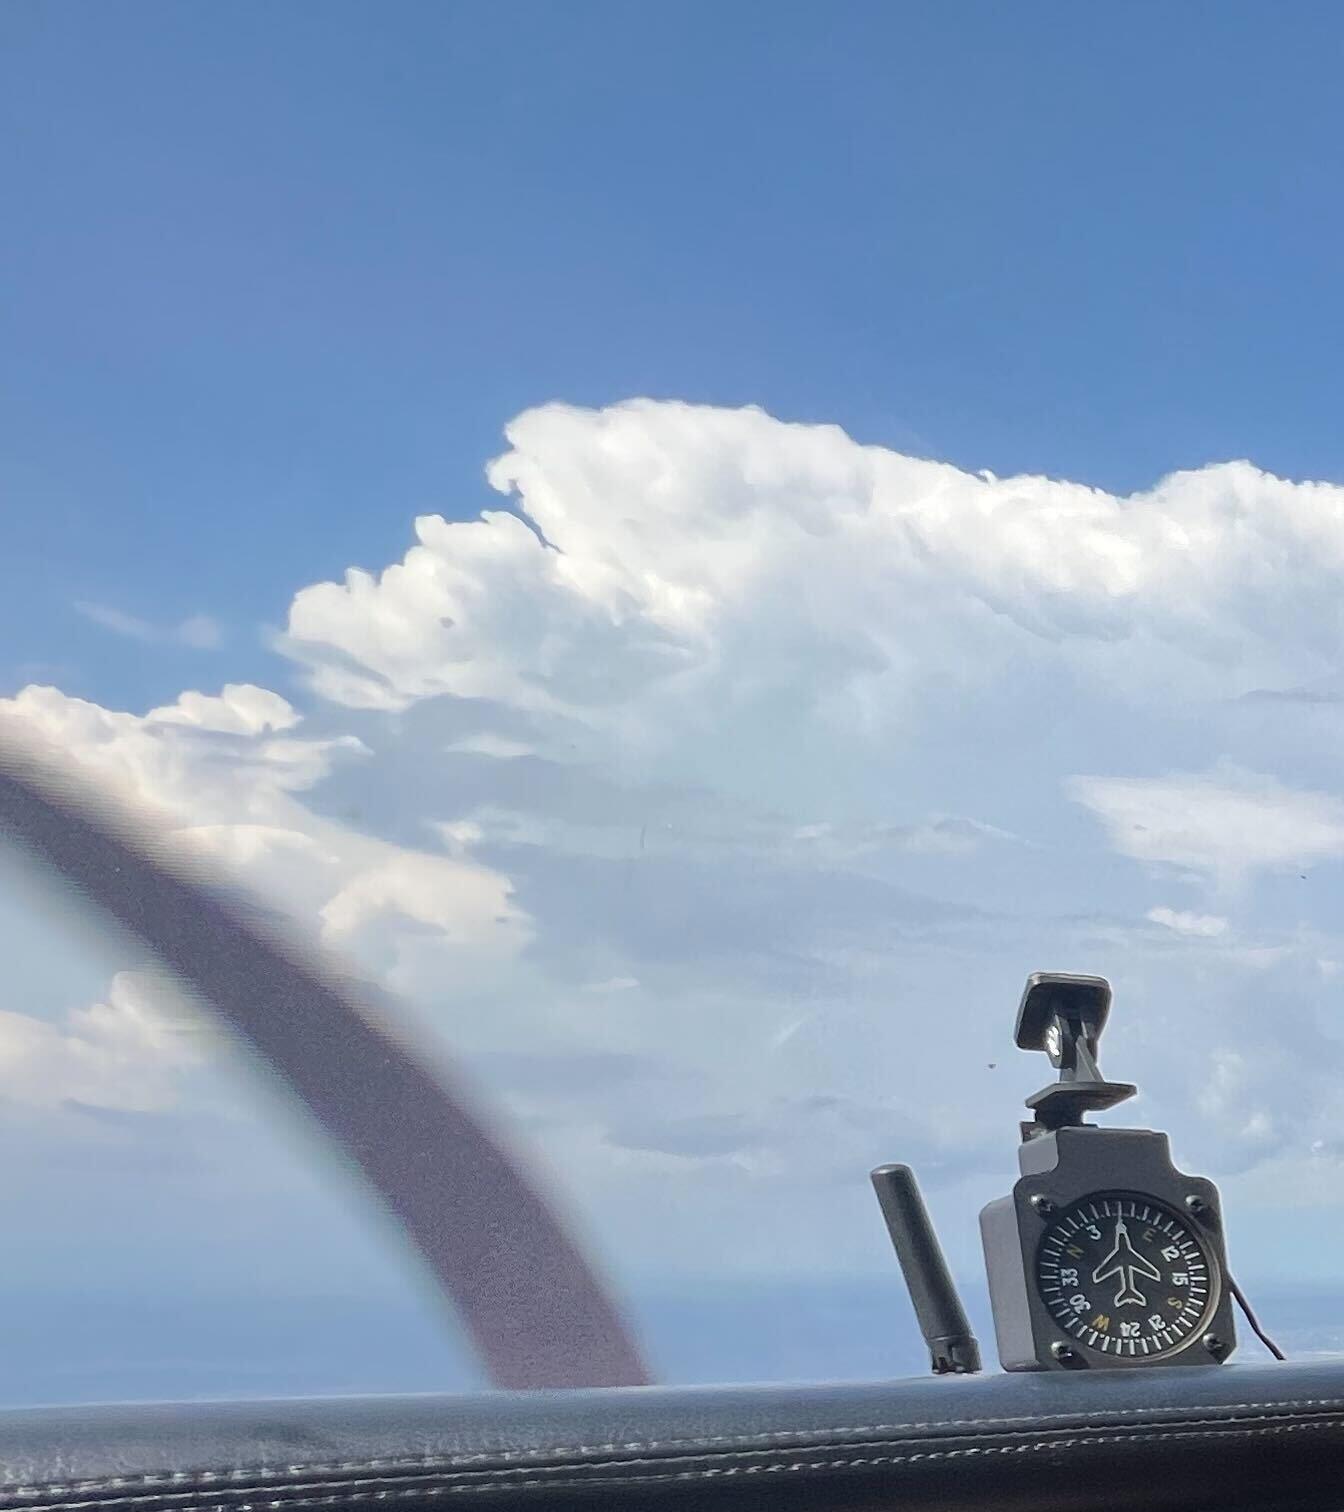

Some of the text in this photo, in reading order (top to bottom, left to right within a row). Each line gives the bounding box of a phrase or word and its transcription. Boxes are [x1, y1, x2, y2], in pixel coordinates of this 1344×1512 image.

[1085, 1224, 1102, 1241] 3
[1142, 1228, 1157, 1243] E
[1065, 1243, 1085, 1260] N
[1160, 1247, 1180, 1262] 12
[1060, 1268, 1080, 1287] 33
[1171, 1271, 1189, 1286] 15
[1068, 1293, 1091, 1315] 30
[1167, 1296, 1183, 1310] S
[1091, 1313, 1111, 1331] W
[1119, 1321, 1141, 1338] 24
[1147, 1313, 1167, 1331] 21
